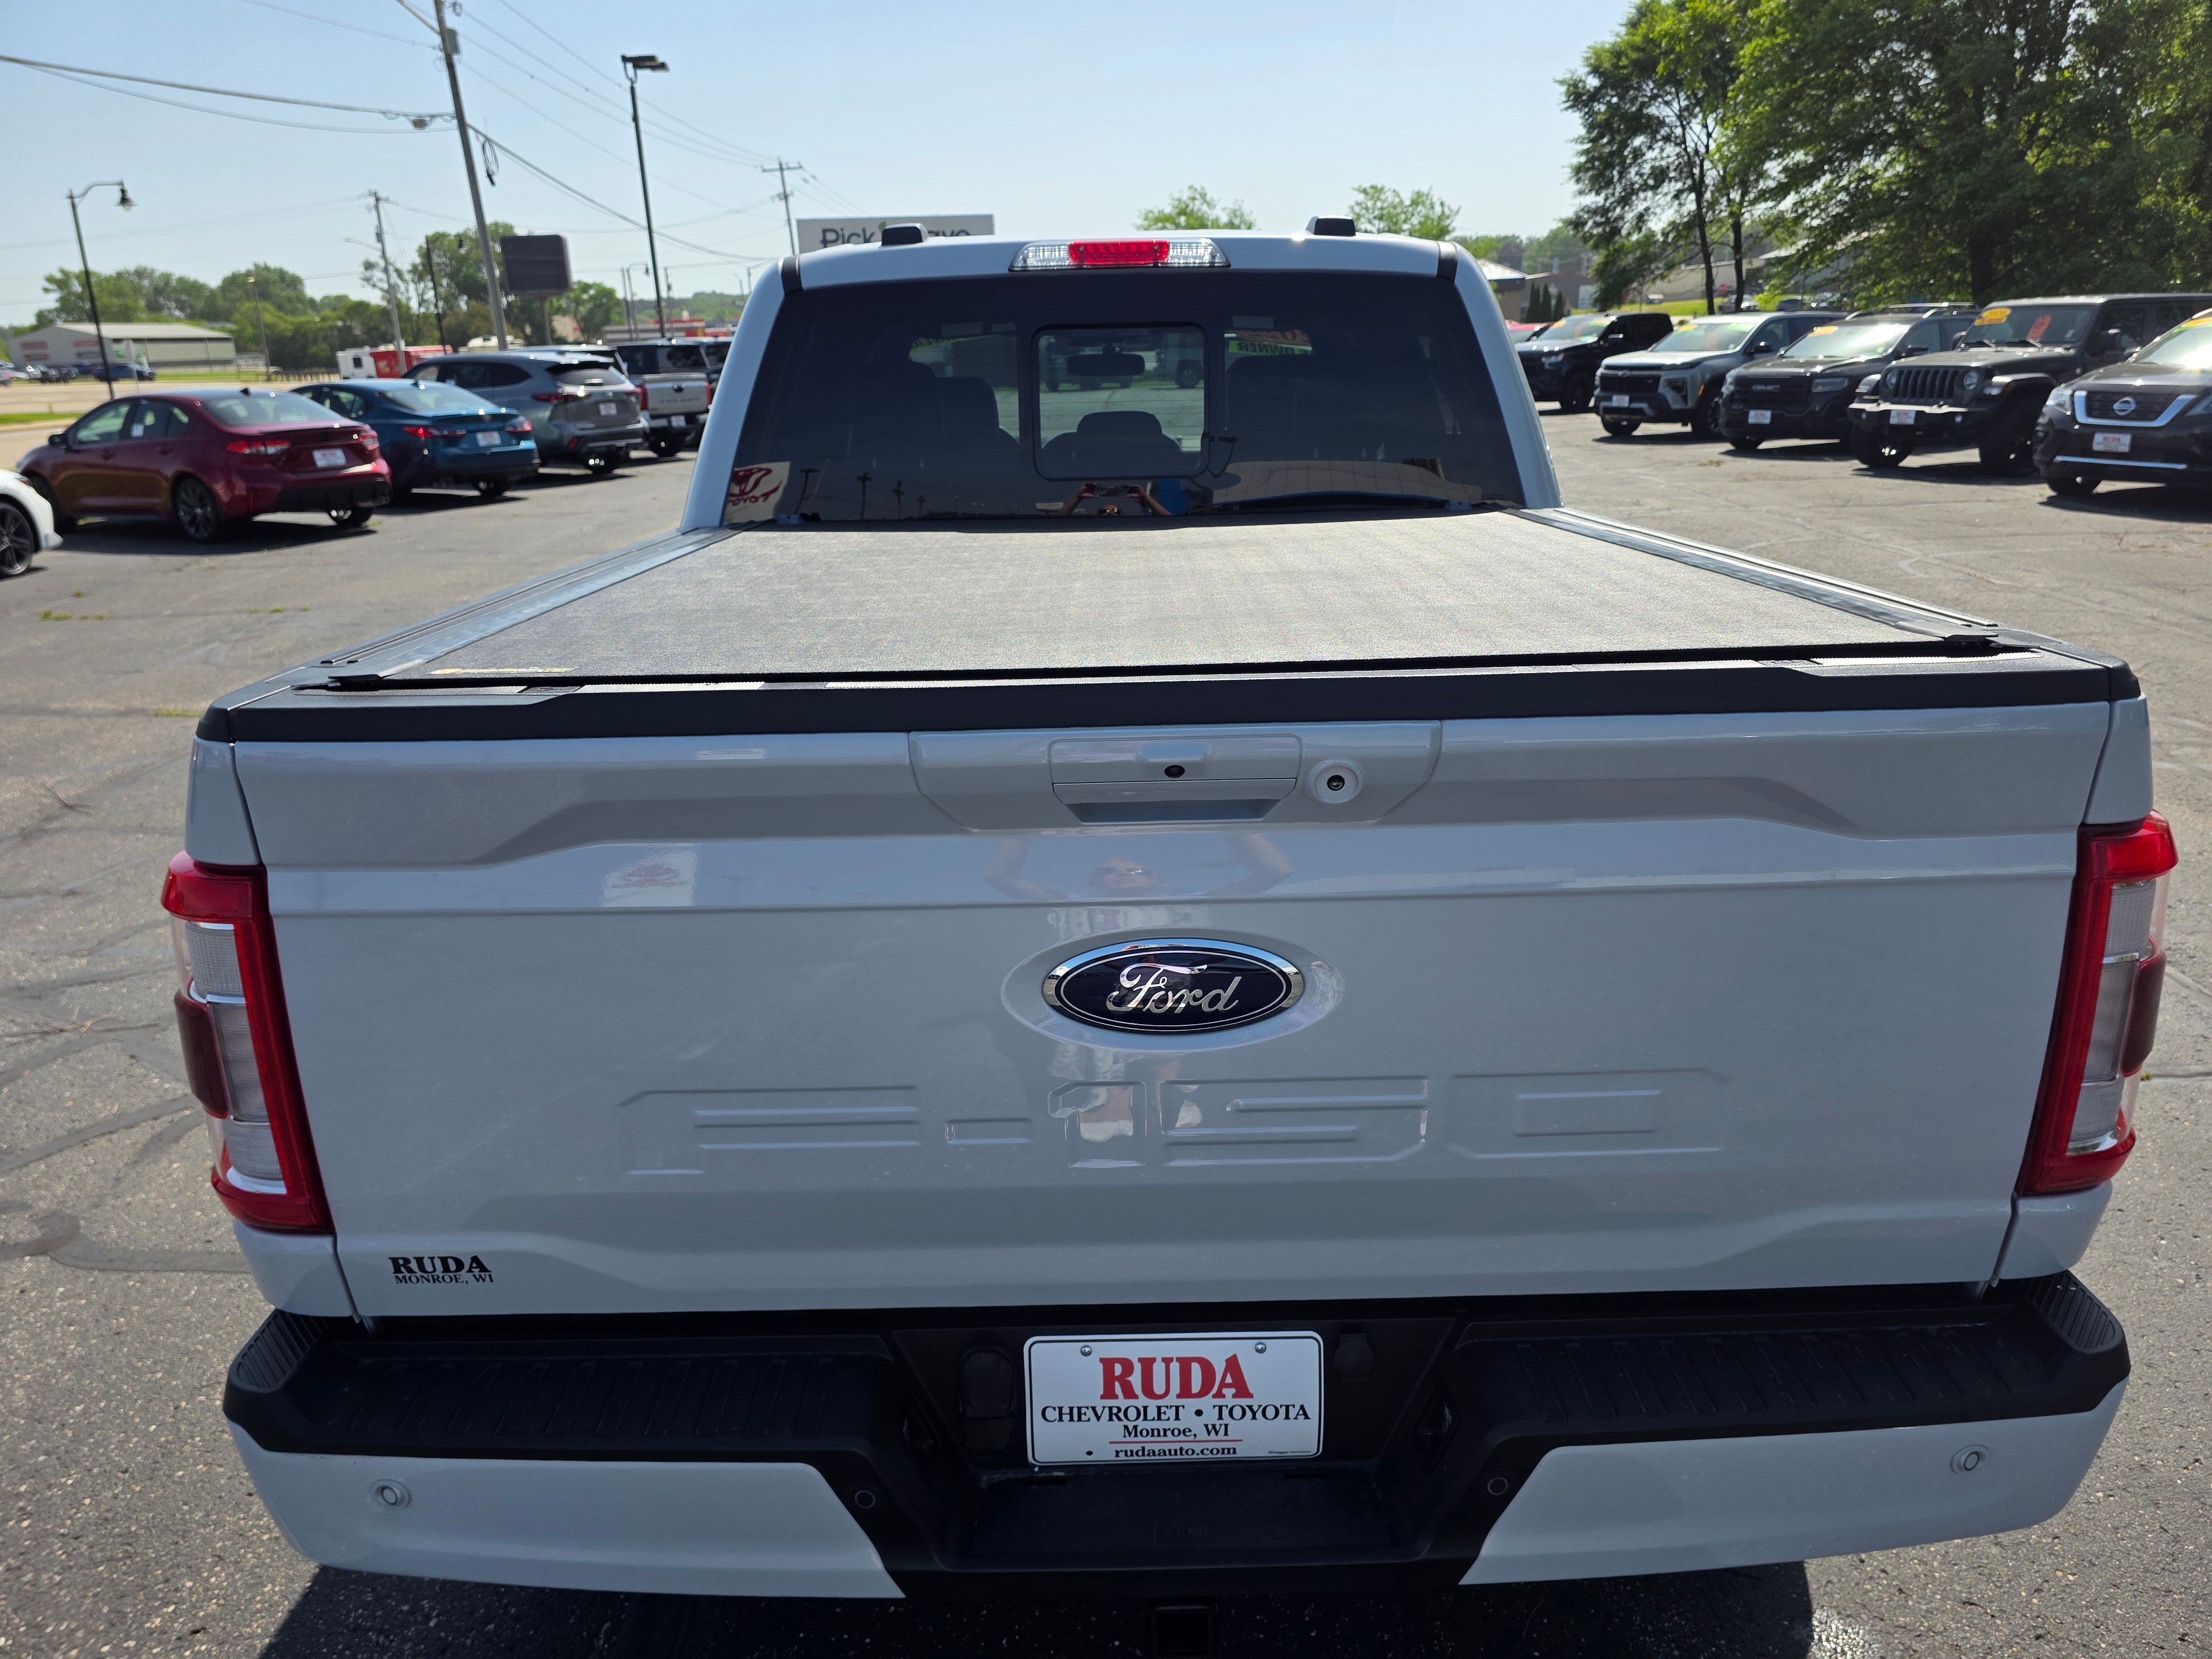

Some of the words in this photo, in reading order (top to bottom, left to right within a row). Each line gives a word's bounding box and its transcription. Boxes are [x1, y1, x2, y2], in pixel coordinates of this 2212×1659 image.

[821, 227, 875, 248] Pick
[1106, 963, 1241, 1014] Ford
[388, 1255, 492, 1274] RUDA
[394, 1274, 468, 1285] MONROE,
[472, 1274, 494, 1283] WI
[1099, 1353, 1254, 1400] RUDA
[1041, 1405, 1185, 1423] CHEVROLET
[1213, 1404, 1311, 1421] TOYOTA
[1123, 1425, 1197, 1439] Monroe,
[1203, 1423, 1229, 1437] WI
[1114, 1446, 1237, 1458] rudaauto.com
